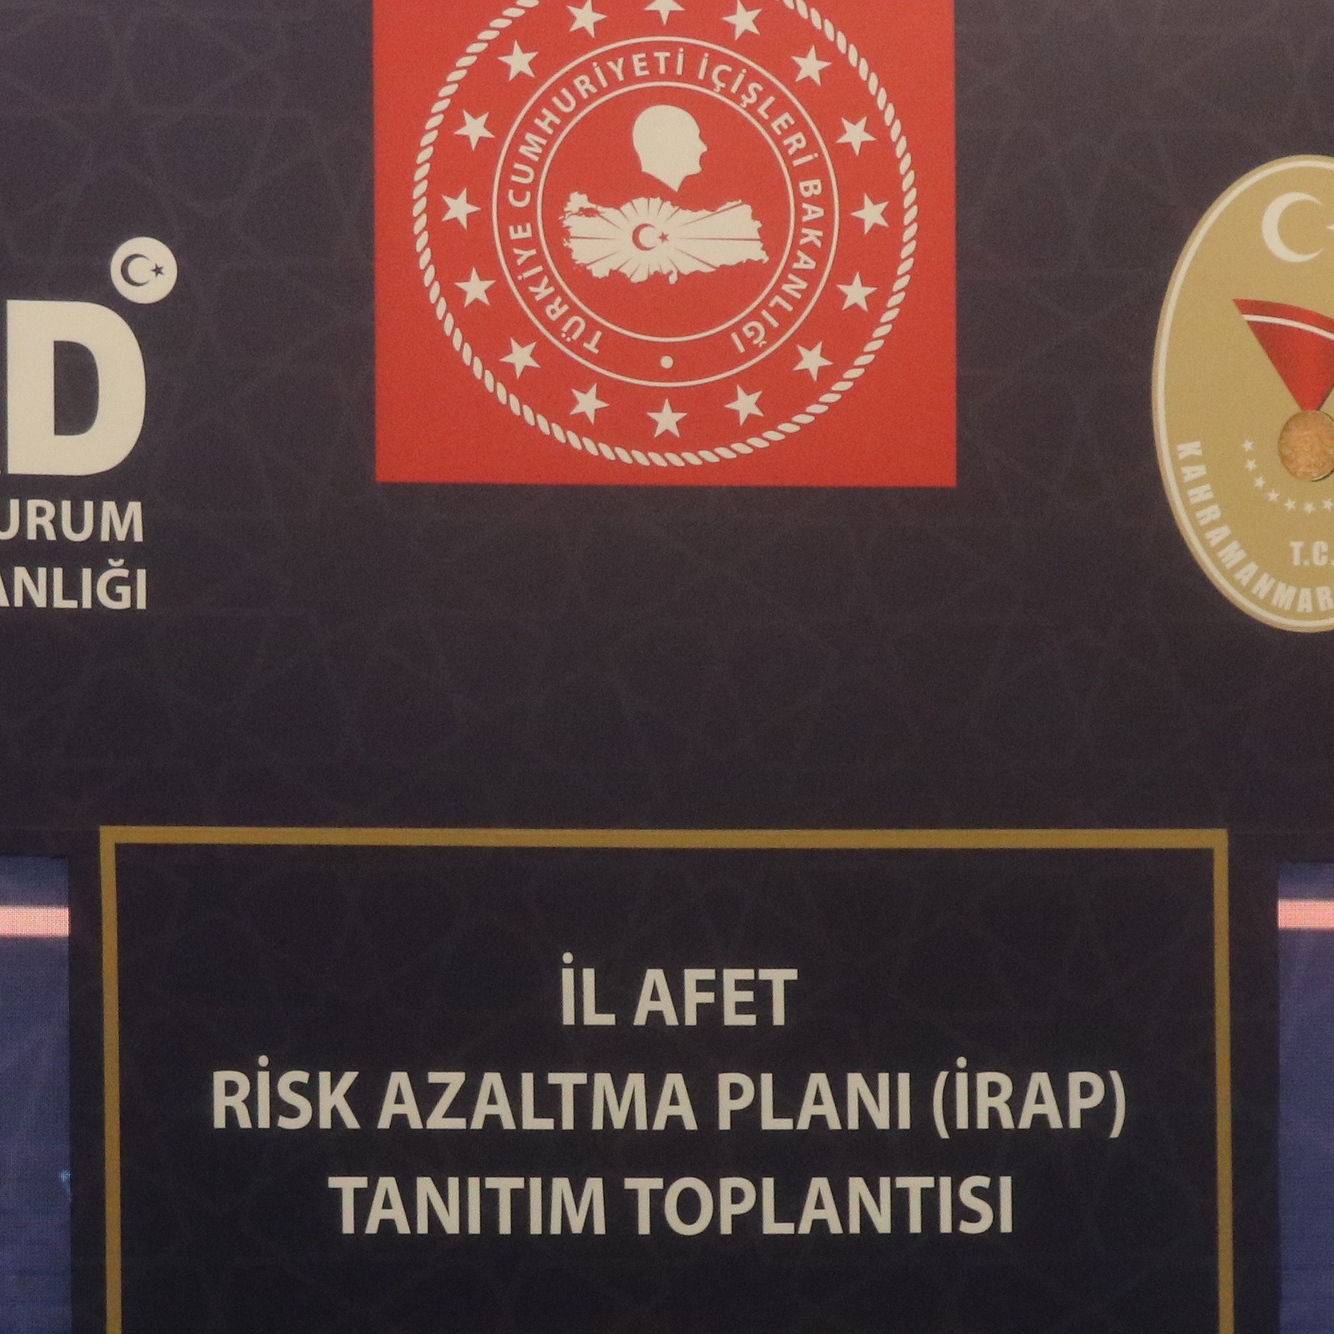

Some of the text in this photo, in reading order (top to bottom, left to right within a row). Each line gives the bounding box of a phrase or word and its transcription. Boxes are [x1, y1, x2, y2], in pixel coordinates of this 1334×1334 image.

[508, 48, 823, 354] TÜRKİYE CUMHURİYETİ İÇİŞLERİ BAKANLIĞI
[561, 951, 798, 1027] İL AFET
[211, 1056, 1127, 1138] RİSK AZALTMA PLANI (İRAP)
[328, 1176, 1012, 1235] TANITIM TOPLANTISI
